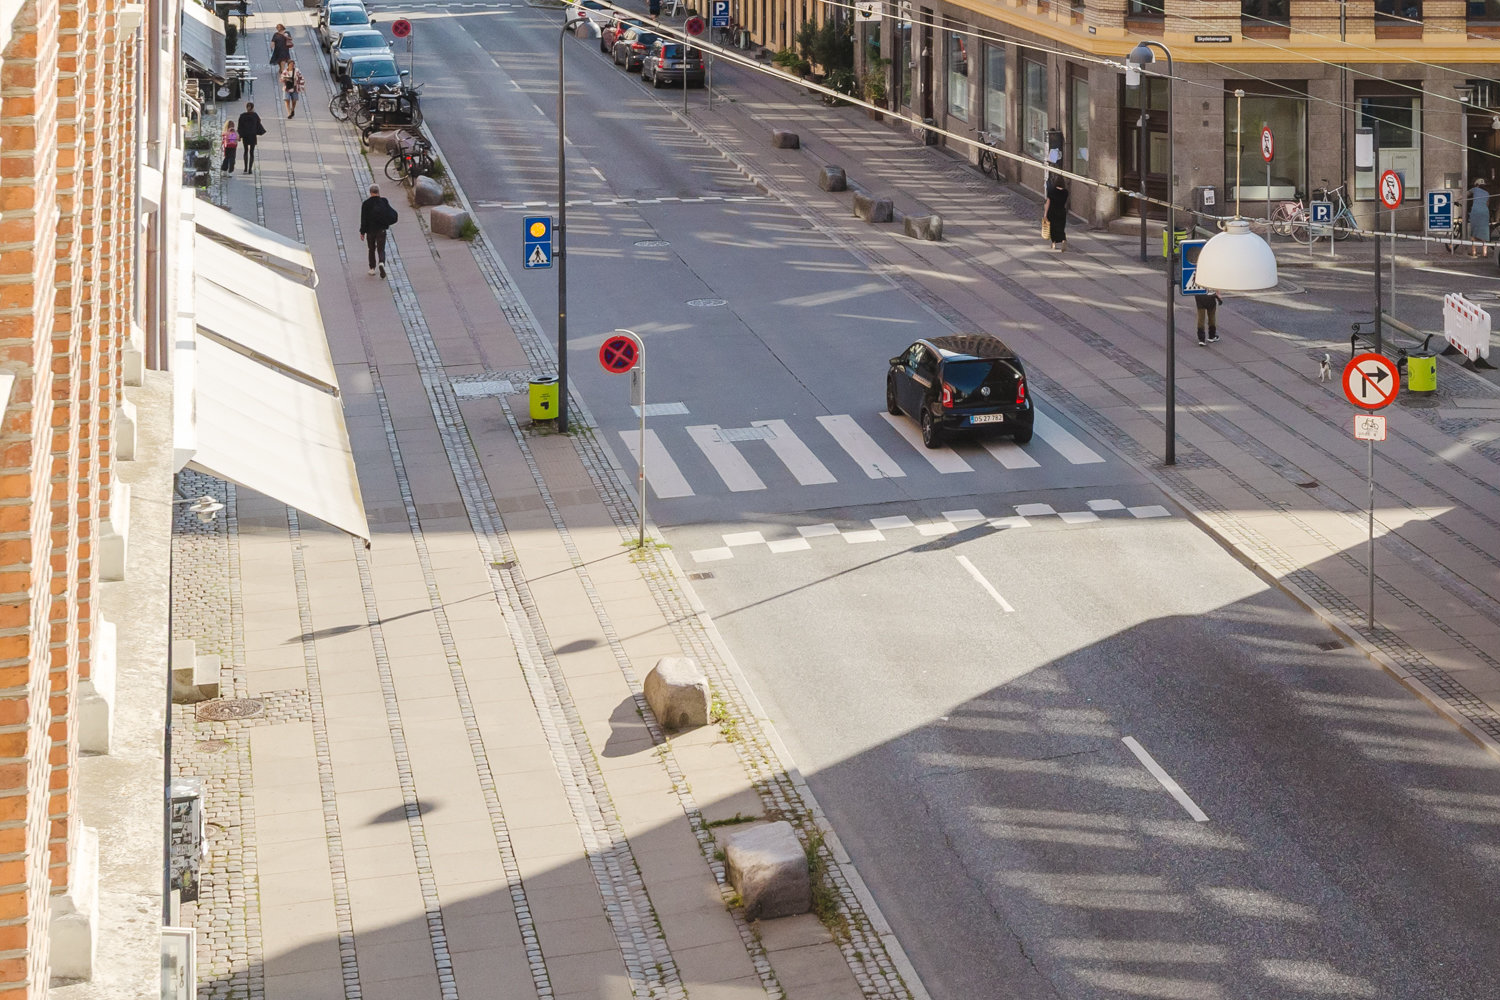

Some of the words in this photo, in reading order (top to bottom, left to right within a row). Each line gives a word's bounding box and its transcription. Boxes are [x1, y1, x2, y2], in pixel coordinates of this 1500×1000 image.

[716, 2, 726, 15] P
[1433, 194, 1448, 213] P
[1317, 206, 1327, 220] P
